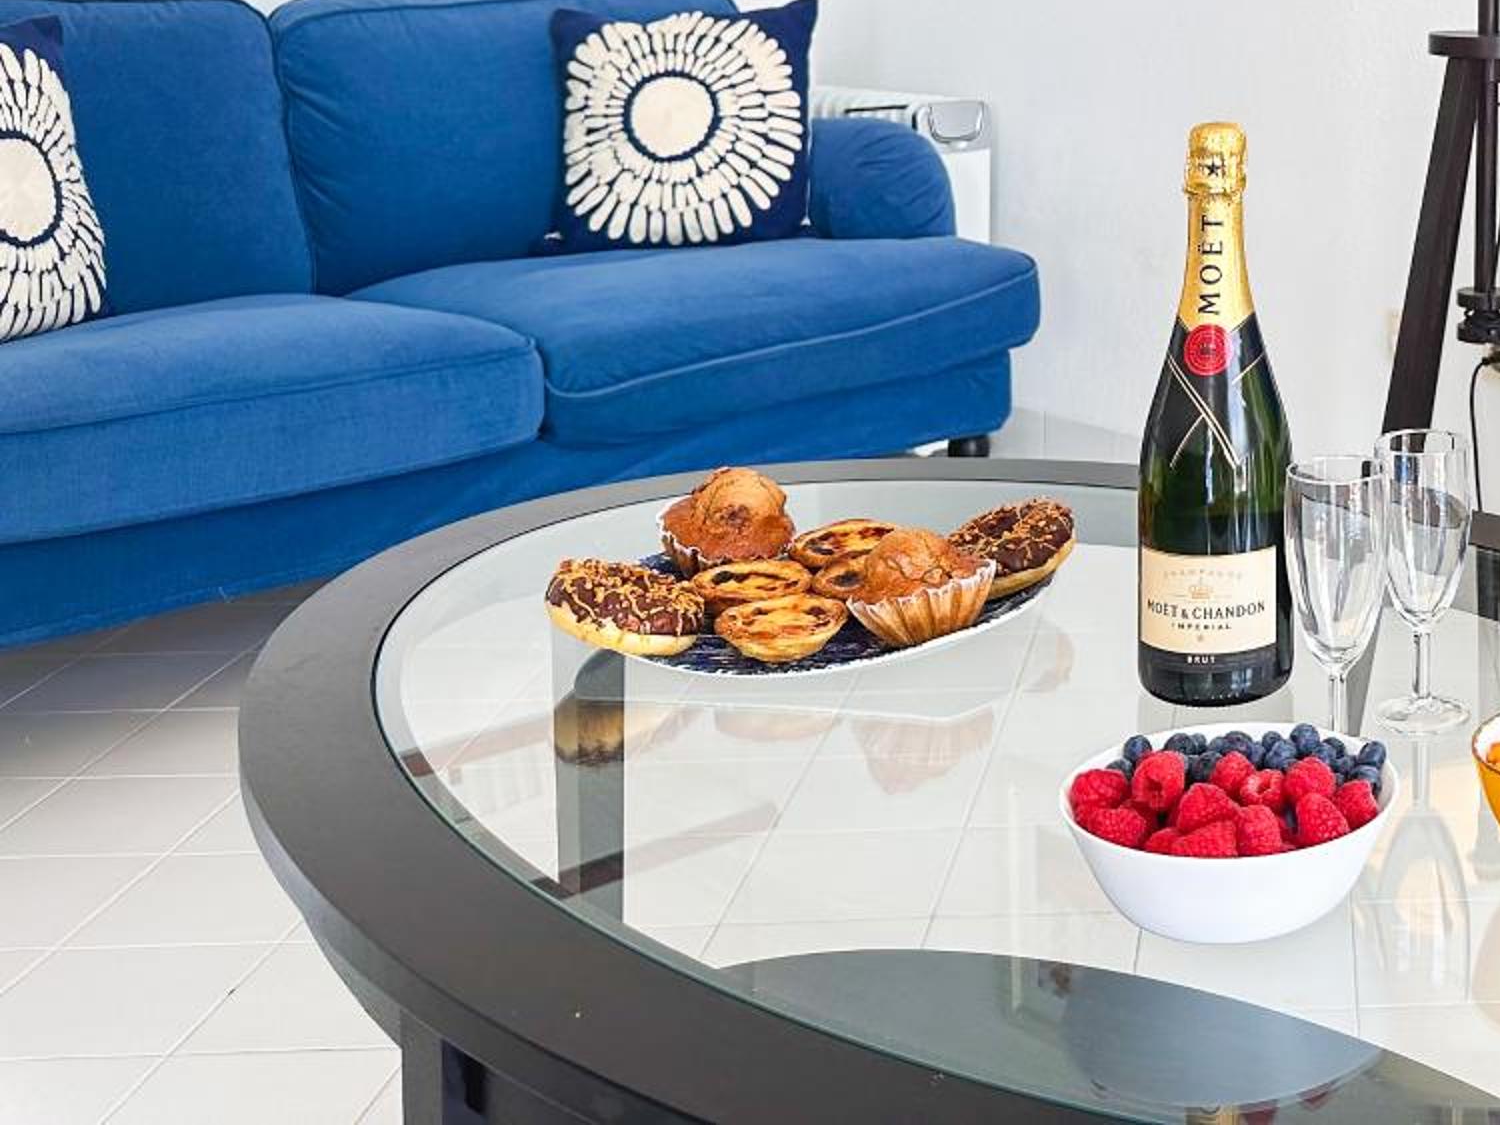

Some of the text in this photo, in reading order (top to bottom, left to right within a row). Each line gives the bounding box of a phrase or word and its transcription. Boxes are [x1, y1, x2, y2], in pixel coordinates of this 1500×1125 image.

[1197, 214, 1224, 315] MOËT
[1181, 608, 1189, 620] &
[1192, 600, 1265, 620] CHANDON
[1187, 655, 1215, 664] BRUT
